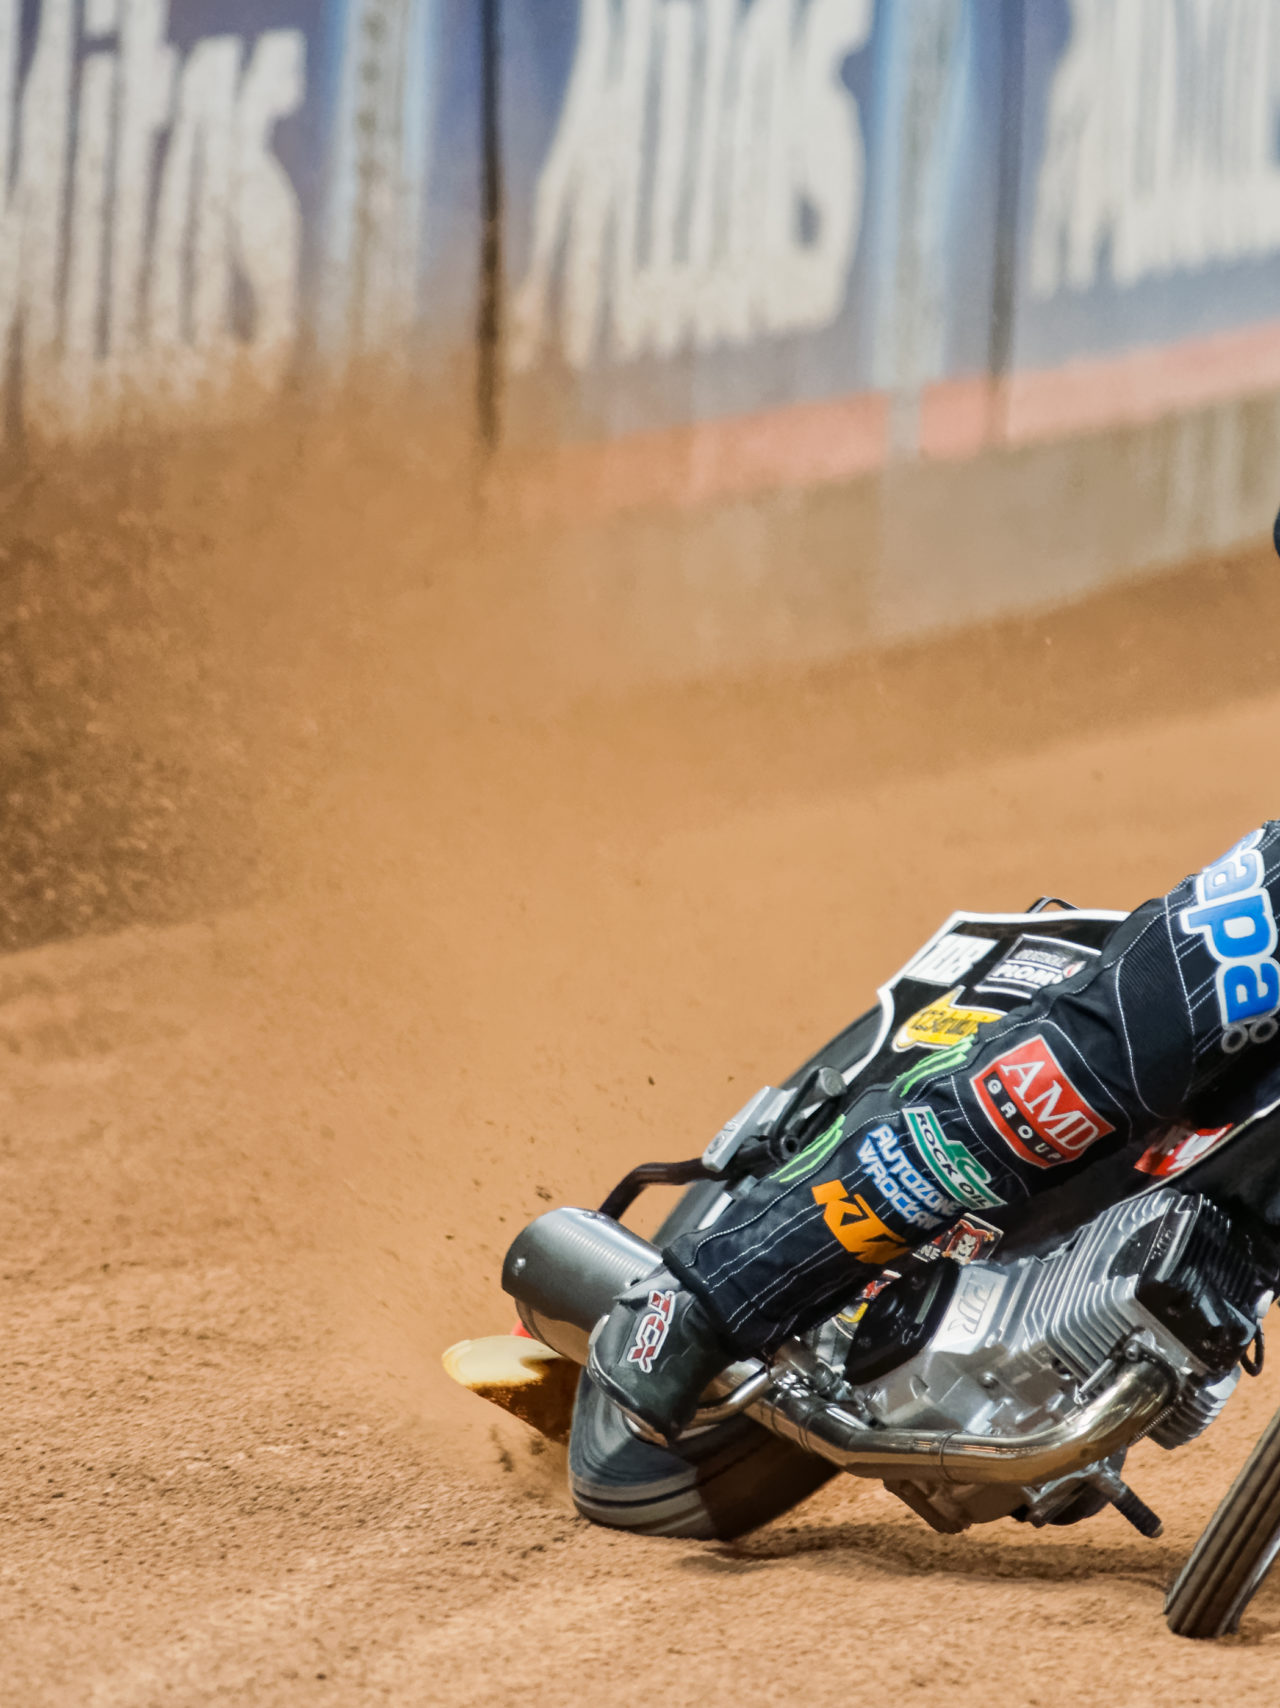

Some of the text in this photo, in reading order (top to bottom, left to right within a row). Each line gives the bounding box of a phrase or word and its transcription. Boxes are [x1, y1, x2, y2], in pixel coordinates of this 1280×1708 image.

[987, 1079, 1062, 1160] GROUP
[1001, 1059, 1100, 1150] AMD
[868, 1124, 958, 1216] AUTOZONE
[916, 1111, 988, 1208] ROCK OIL
